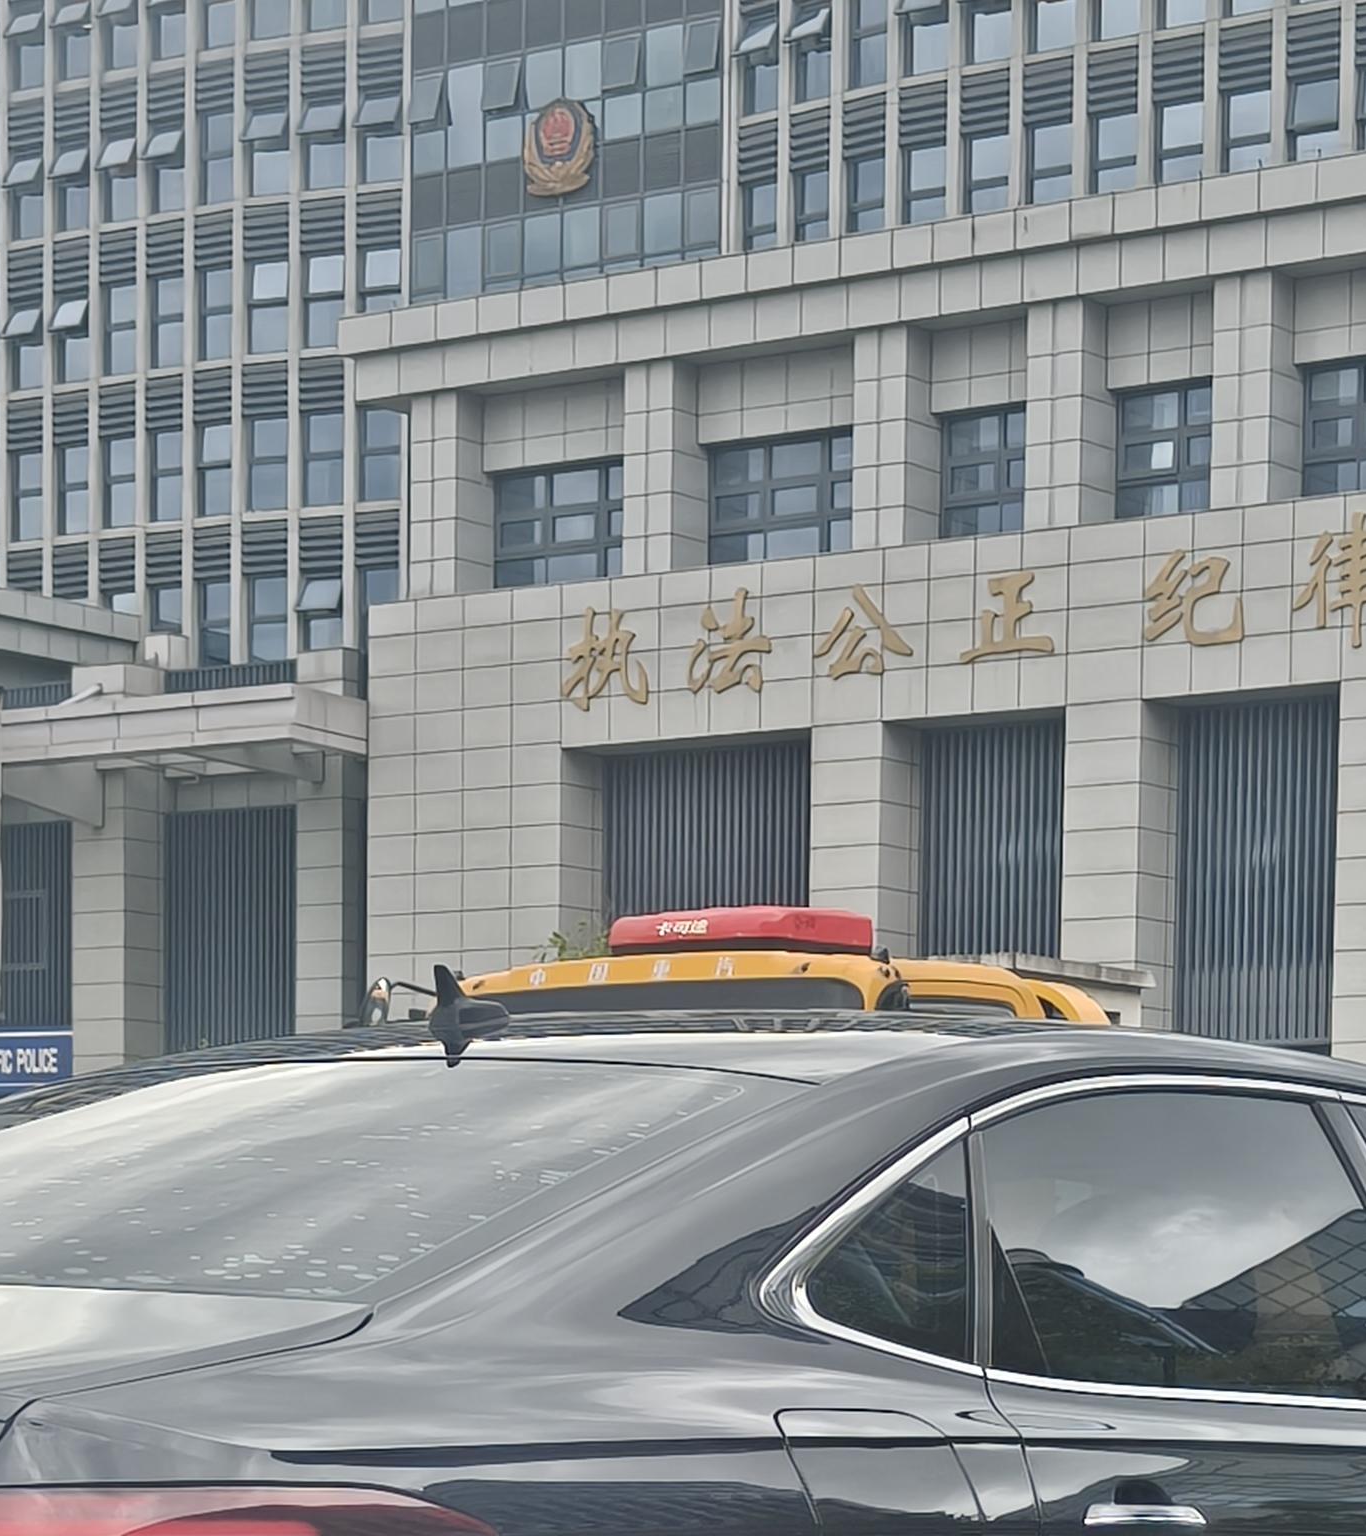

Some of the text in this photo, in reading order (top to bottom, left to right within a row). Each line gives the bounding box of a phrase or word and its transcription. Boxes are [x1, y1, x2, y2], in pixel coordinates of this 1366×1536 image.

[560, 570, 1052, 711] 执法公正
[16, 1046, 58, 1074] POLICE
